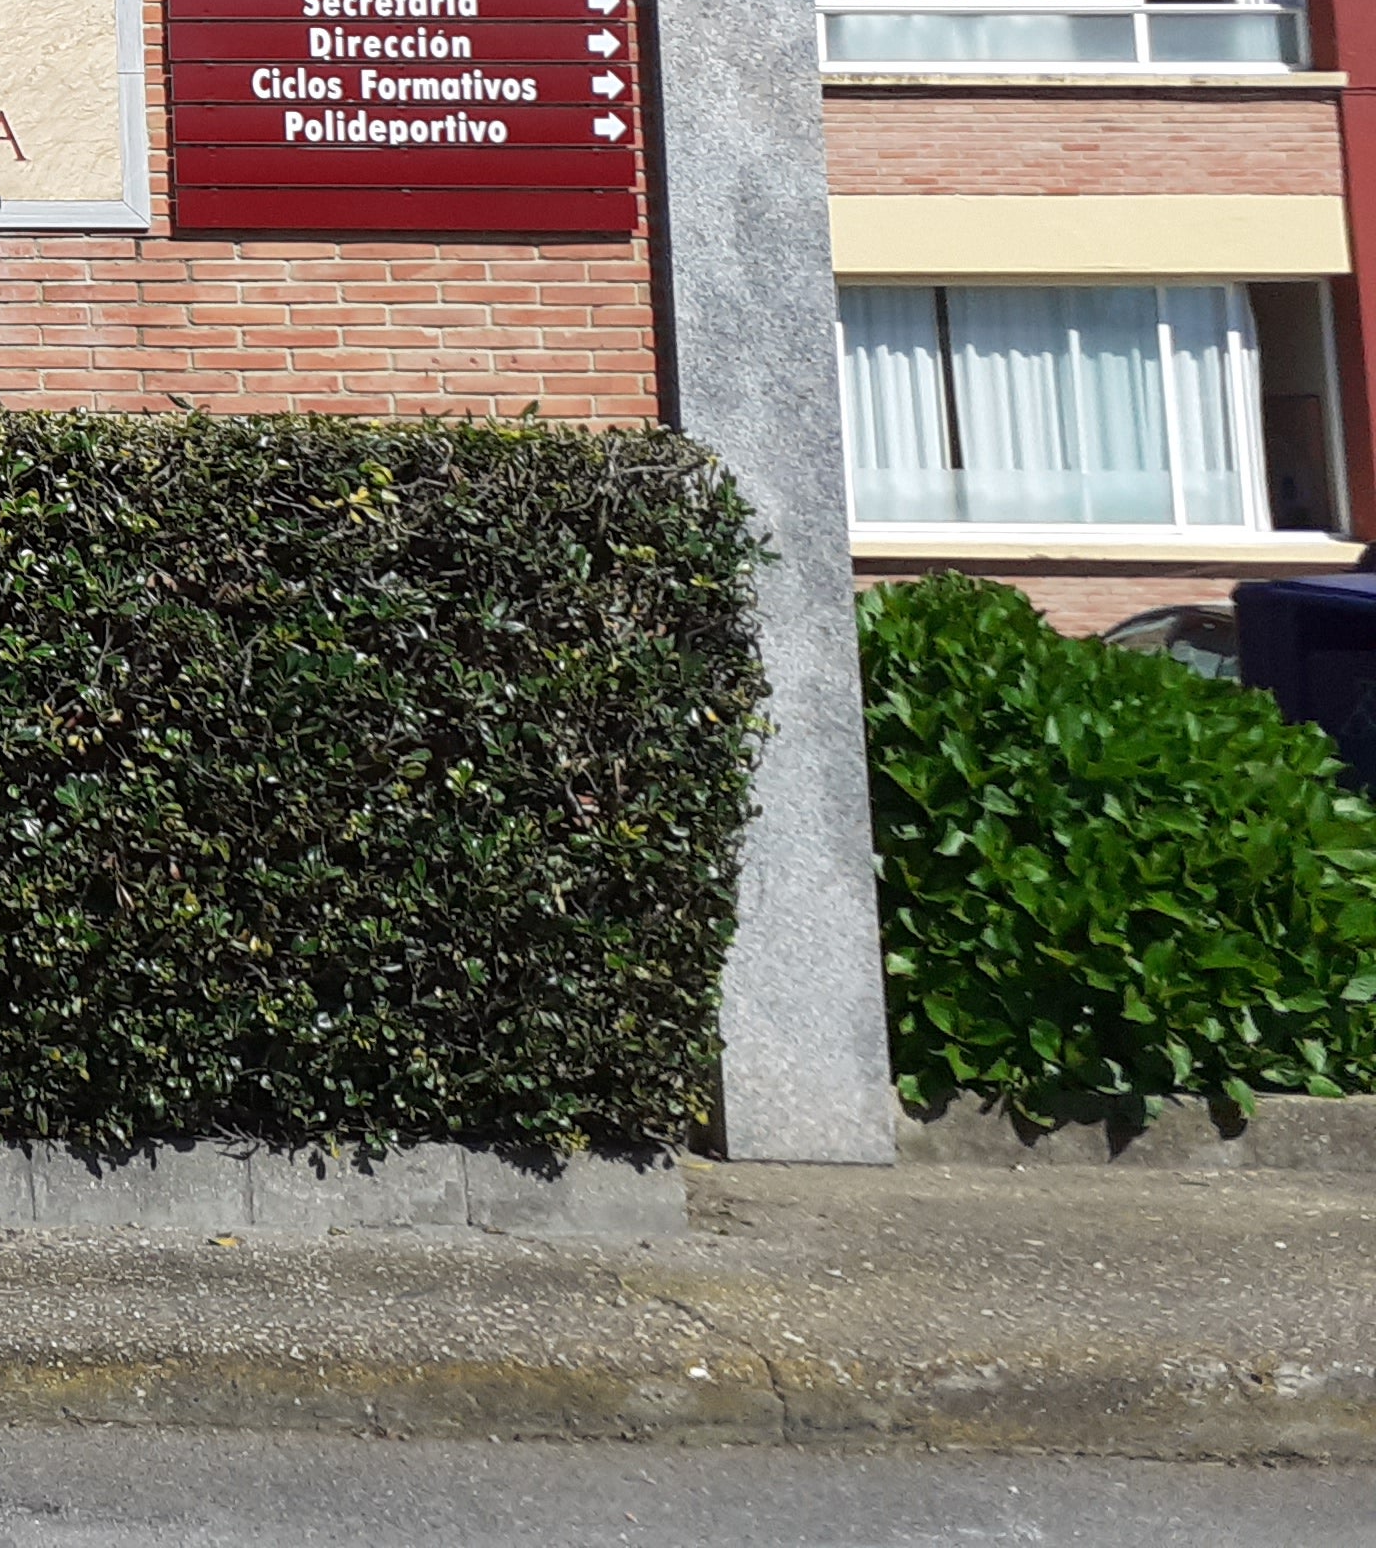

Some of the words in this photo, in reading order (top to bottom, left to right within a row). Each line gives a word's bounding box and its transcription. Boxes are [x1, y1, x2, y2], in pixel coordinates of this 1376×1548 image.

[309, 27, 472, 59] Dirección
[251, 67, 343, 100] Ciclos
[361, 69, 538, 101] Formativos
[284, 111, 508, 145] Polideportivo
